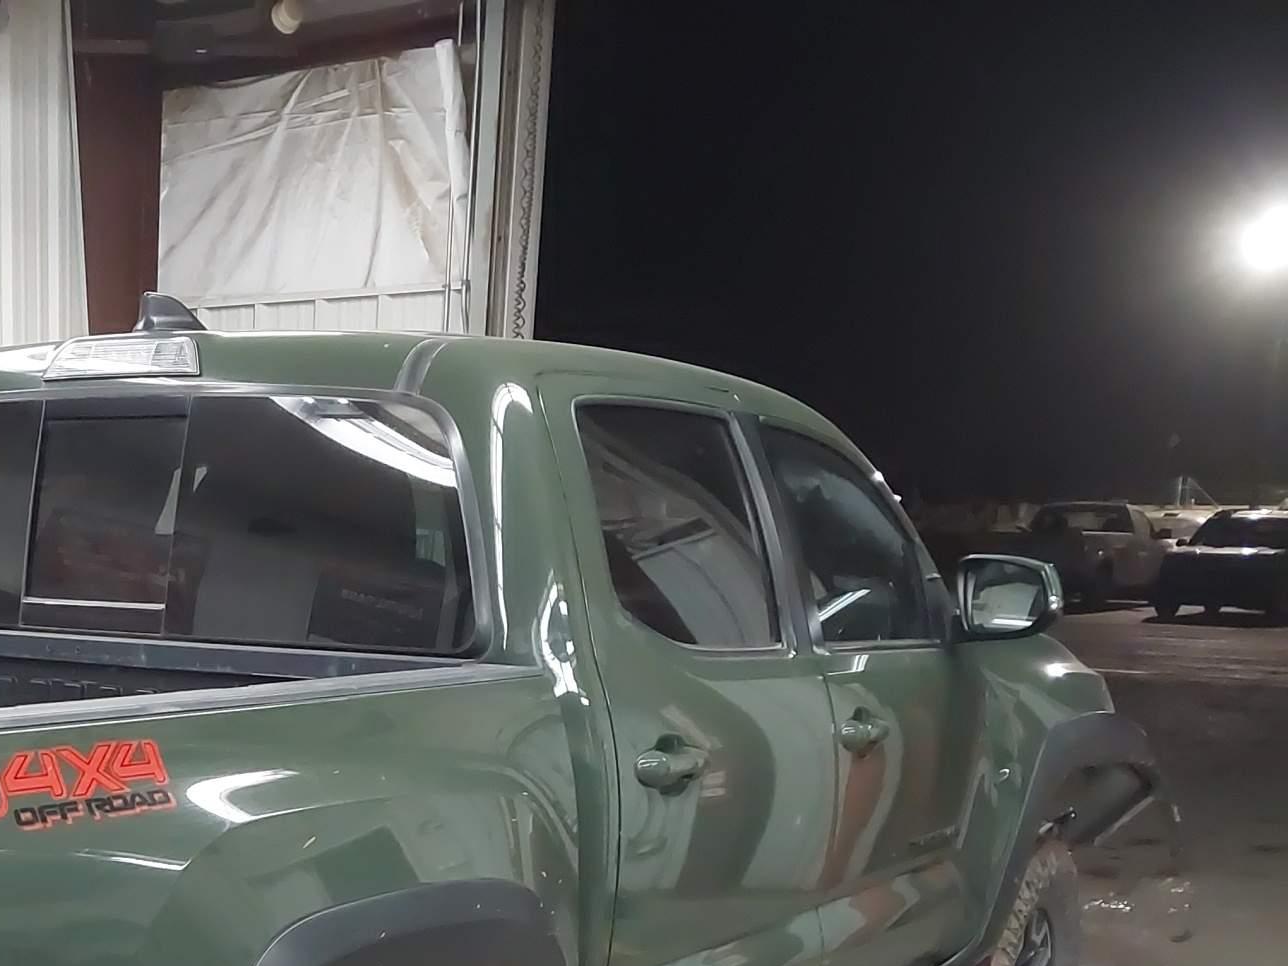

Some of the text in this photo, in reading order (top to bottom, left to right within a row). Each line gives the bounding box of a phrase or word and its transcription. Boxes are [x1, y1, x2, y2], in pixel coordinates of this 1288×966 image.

[1, 739, 170, 798] 4X4
[13, 788, 178, 831] OFF ROAD
